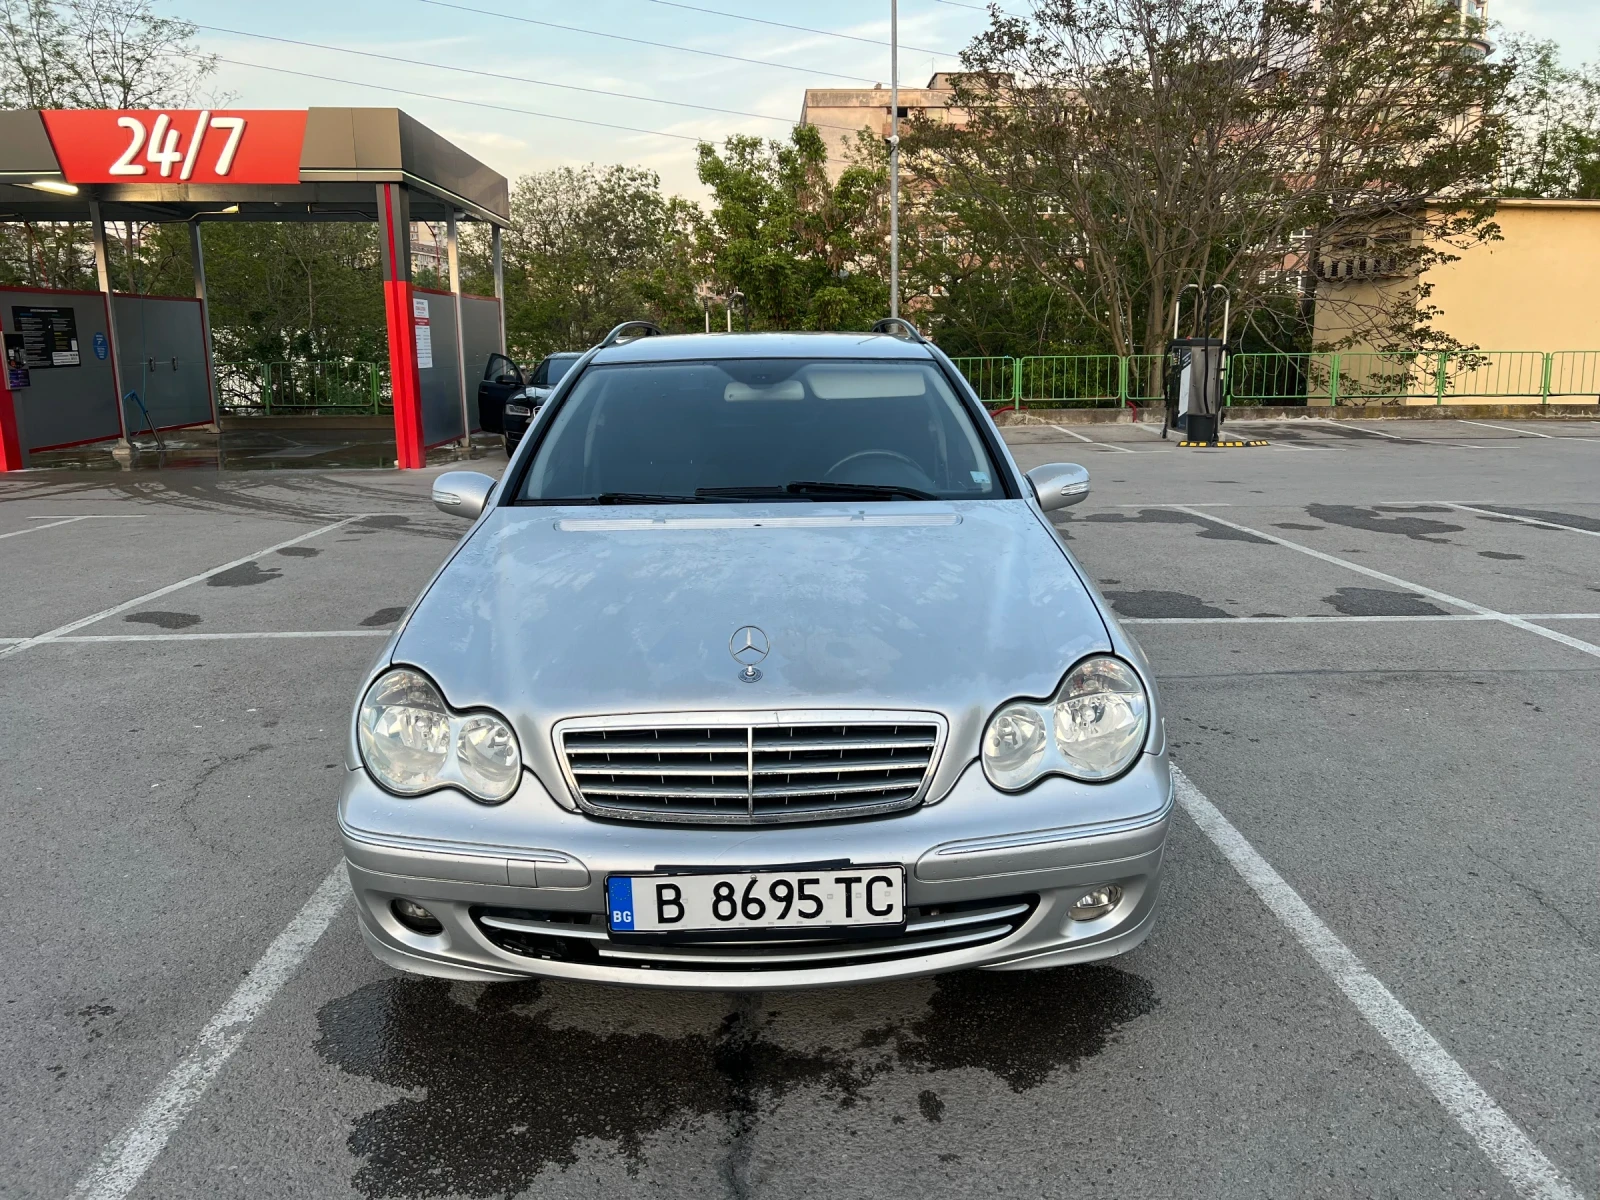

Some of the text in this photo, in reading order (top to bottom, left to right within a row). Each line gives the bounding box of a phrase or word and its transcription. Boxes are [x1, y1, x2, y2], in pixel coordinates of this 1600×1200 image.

[109, 110, 247, 180] 24/7
[613, 910, 632, 923] BG
[656, 876, 894, 923] B 8695 TC
